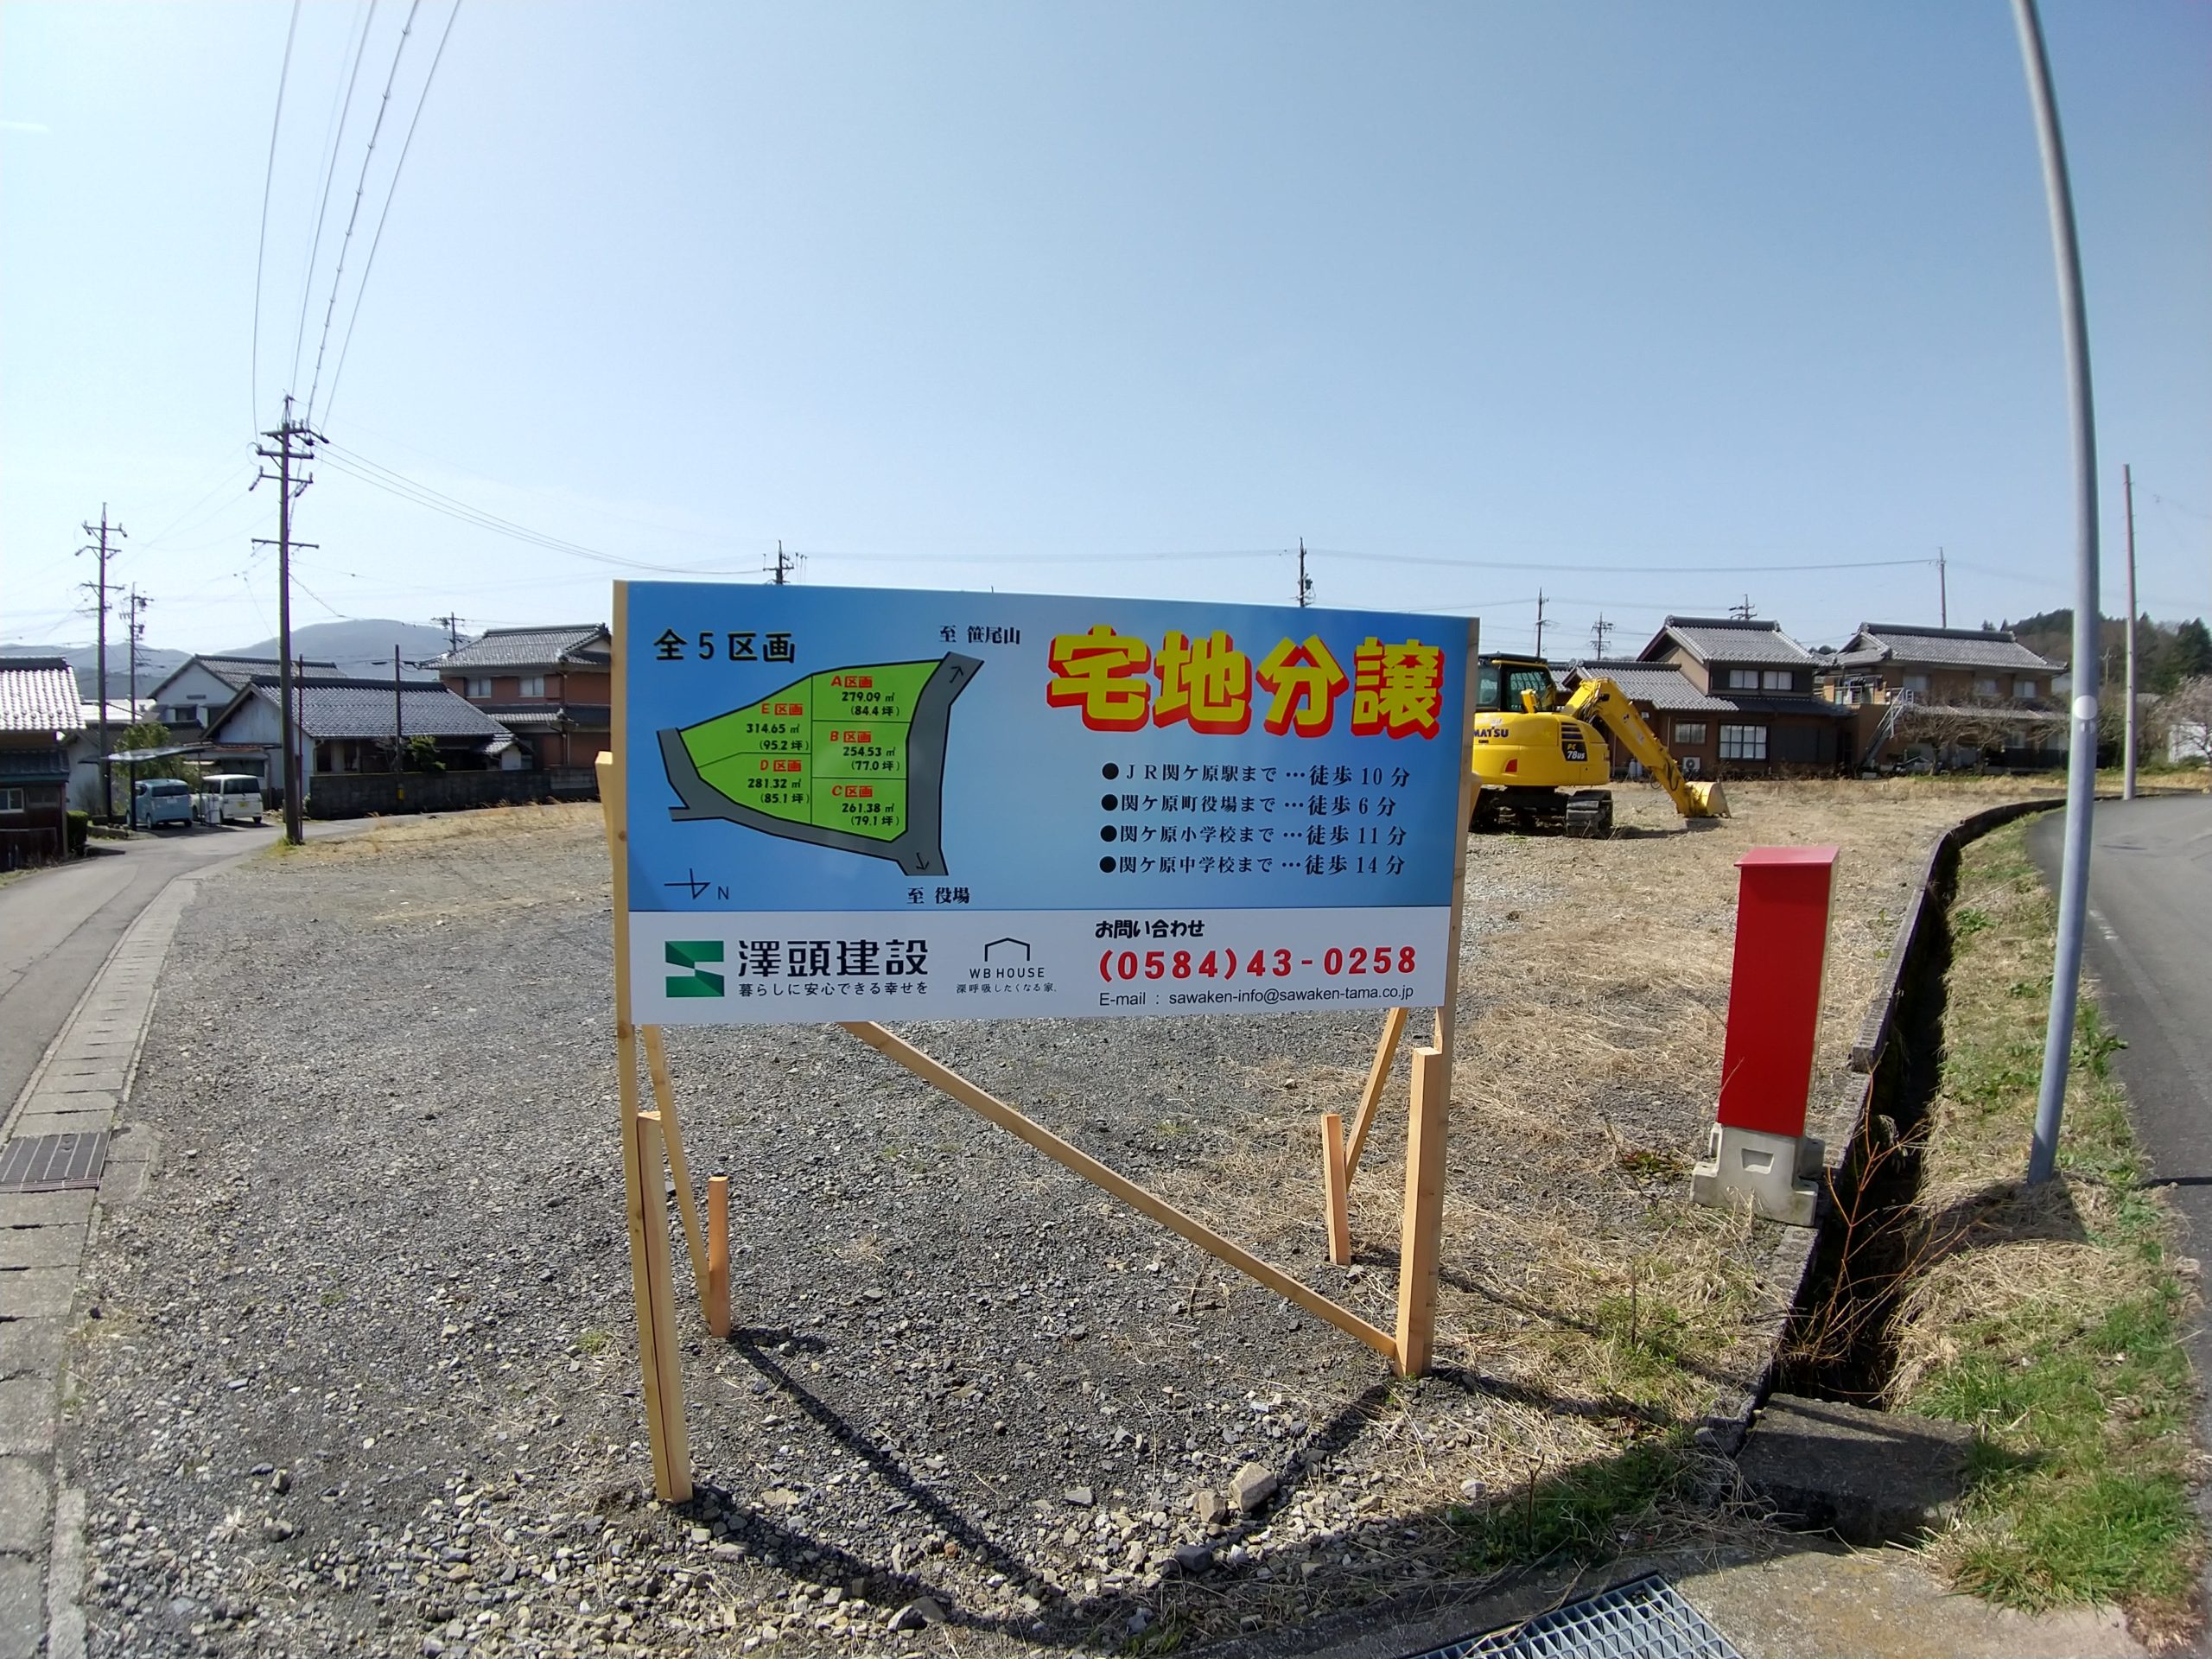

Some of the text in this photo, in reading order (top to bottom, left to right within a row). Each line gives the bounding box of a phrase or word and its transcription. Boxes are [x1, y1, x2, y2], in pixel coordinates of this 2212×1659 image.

[654, 628, 796, 664] 全5区画
[1046, 624, 1446, 740] 宅地分譲
[718, 887, 729, 900] N
[1095, 919, 1205, 939] お問い合わせ
[738, 939, 928, 977] 澤頭建設
[996, 968, 1045, 978] HOUSE
[738, 981, 928, 997] 暮らしに安心できる幸せを
[1099, 992, 1147, 1006] E-mail
[1168, 985, 1414, 1004] sawaken-info@sawaken-tama.co.jp
